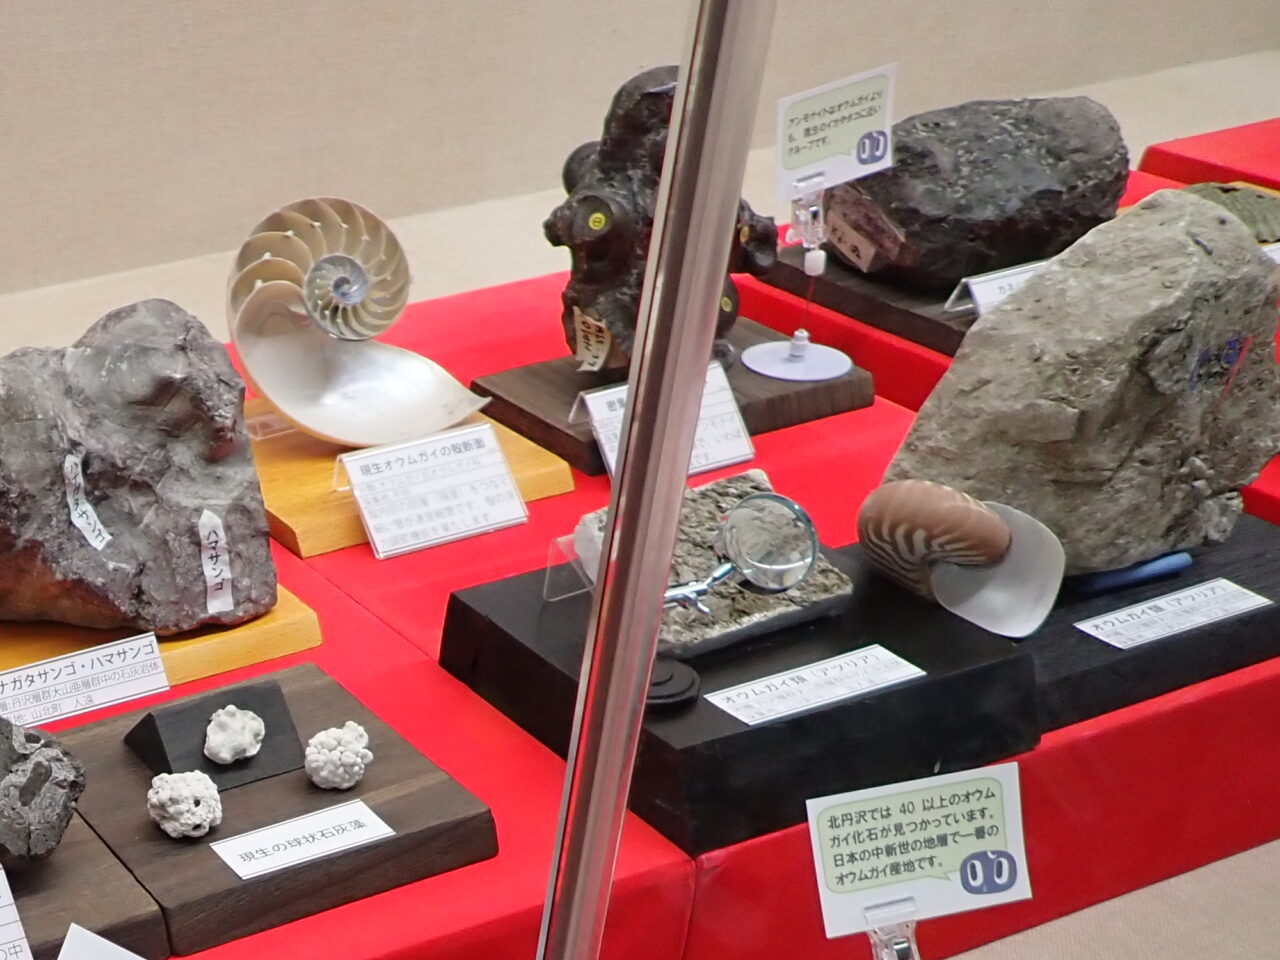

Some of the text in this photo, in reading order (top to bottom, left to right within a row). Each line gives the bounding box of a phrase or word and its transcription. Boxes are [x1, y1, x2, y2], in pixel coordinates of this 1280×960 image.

[206, 529, 224, 591] ハマサンゴ
[829, 807, 994, 849] ガイ化石が見つかっています。
[899, 801, 916, 815] 40
[238, 819, 368, 863] 現生の球状石灰藻
[833, 824, 1000, 867] 日本の中新世の地層で一番の
[835, 855, 943, 887] オウムガイ産地です。
